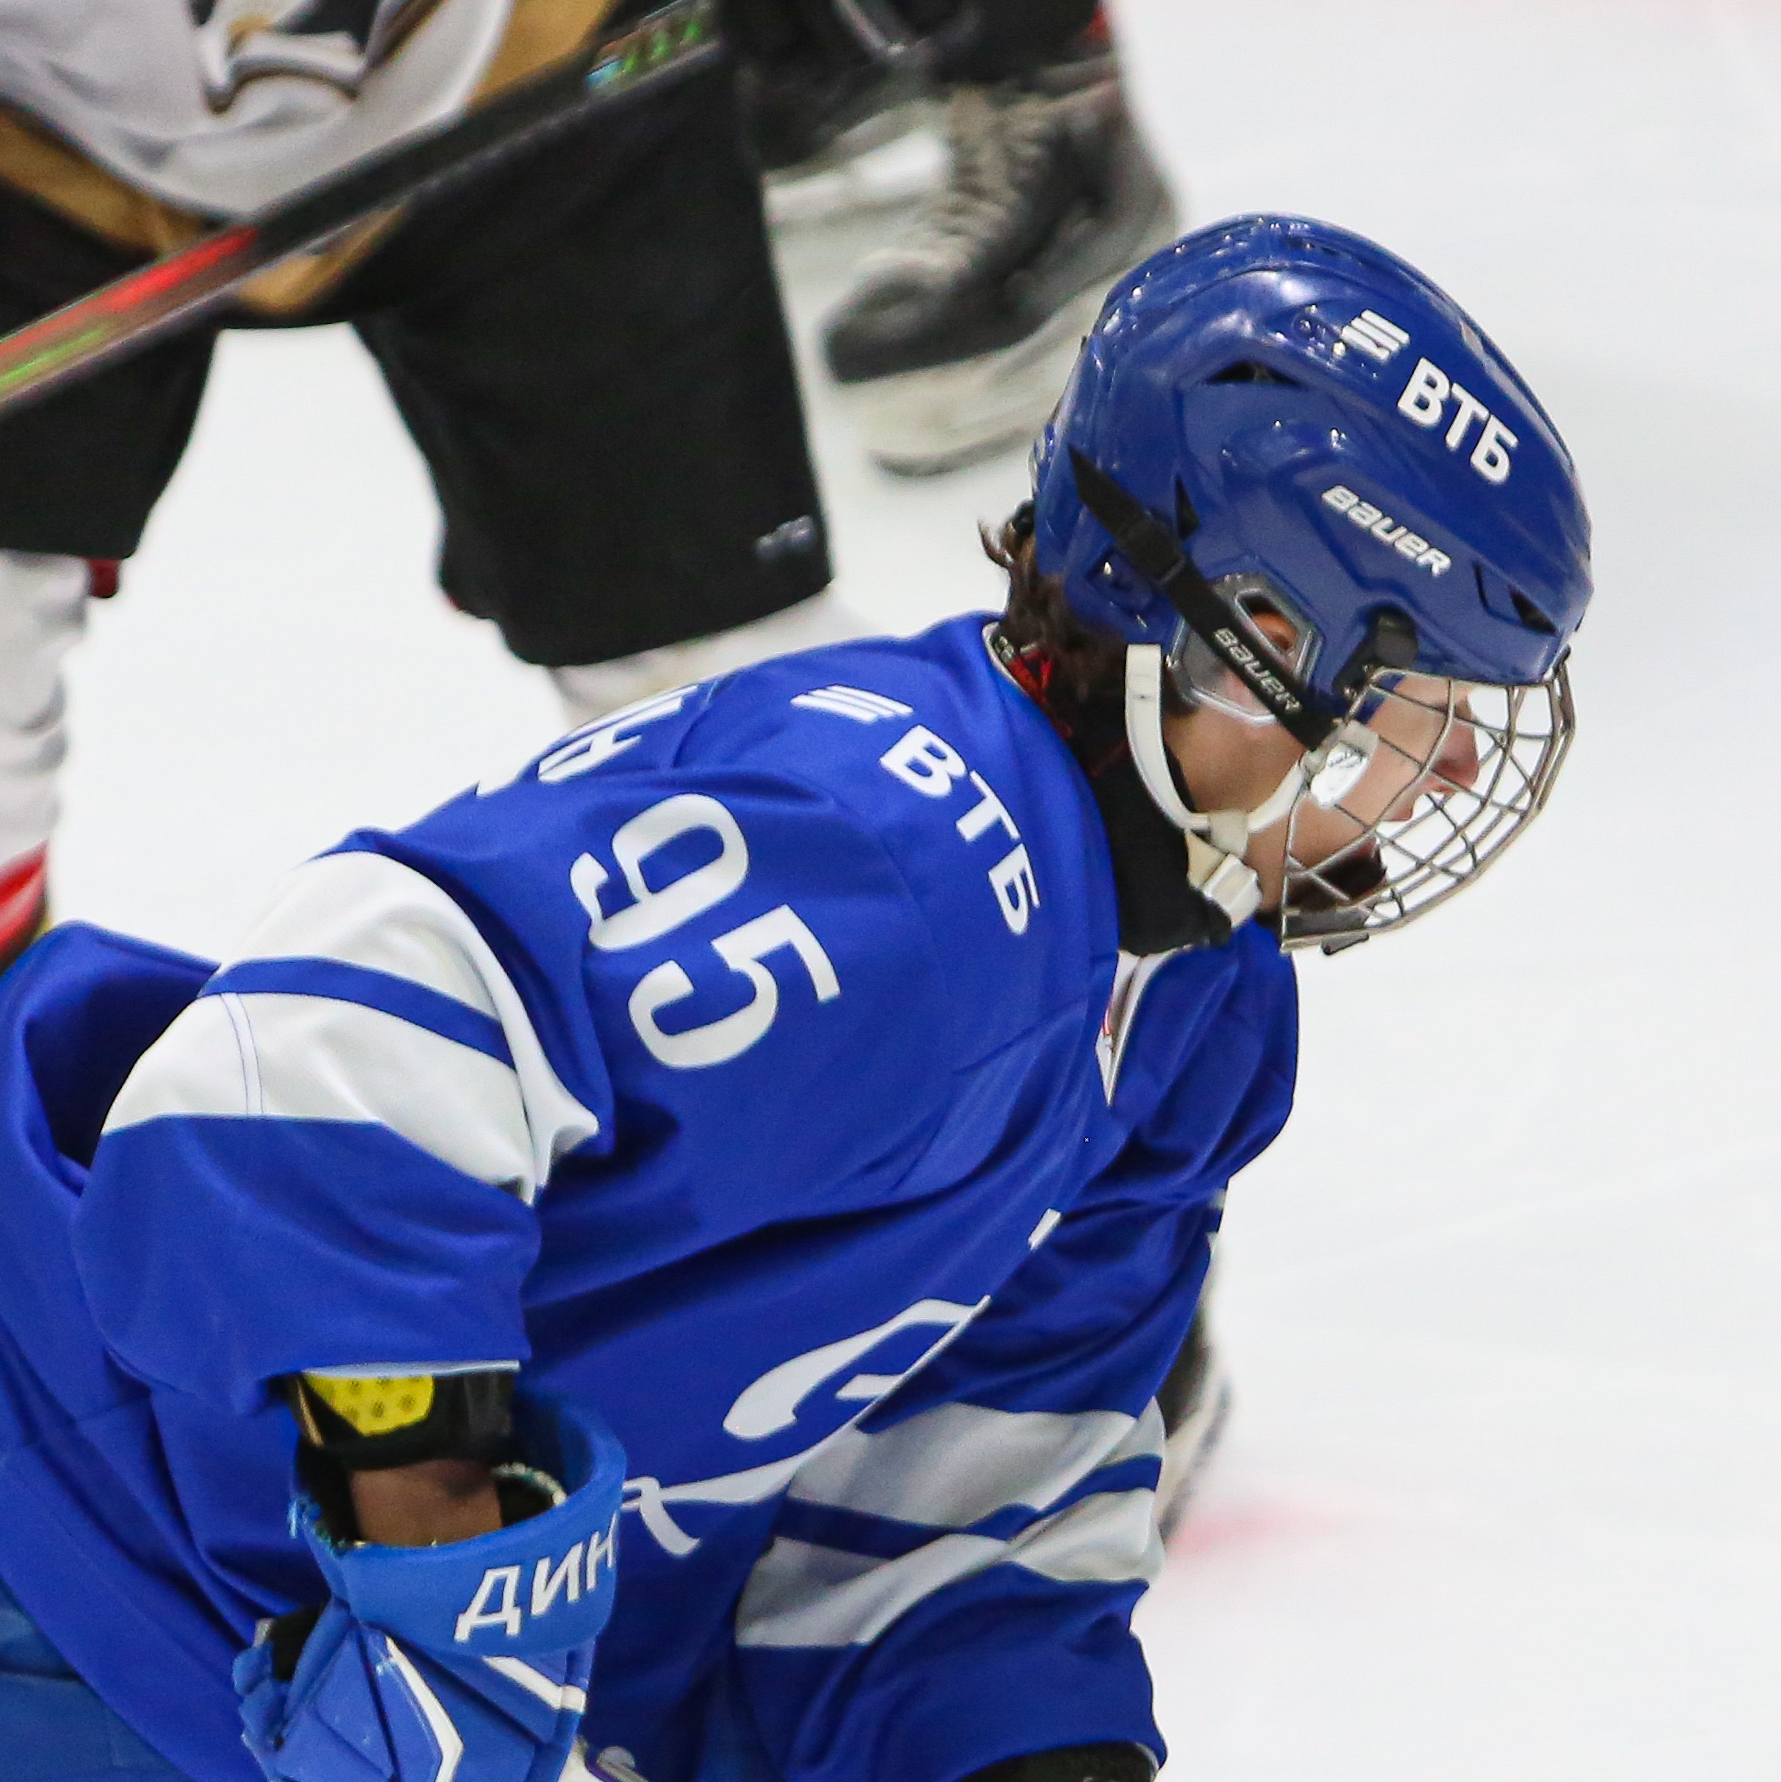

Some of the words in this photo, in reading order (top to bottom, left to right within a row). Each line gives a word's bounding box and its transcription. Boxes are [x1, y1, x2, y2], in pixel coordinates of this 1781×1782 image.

[1397, 357, 1519, 484] ВТБ
[879, 724, 1040, 936] ВТБ
[569, 793, 840, 1069] 95
[453, 1509, 618, 1643] ДИН
